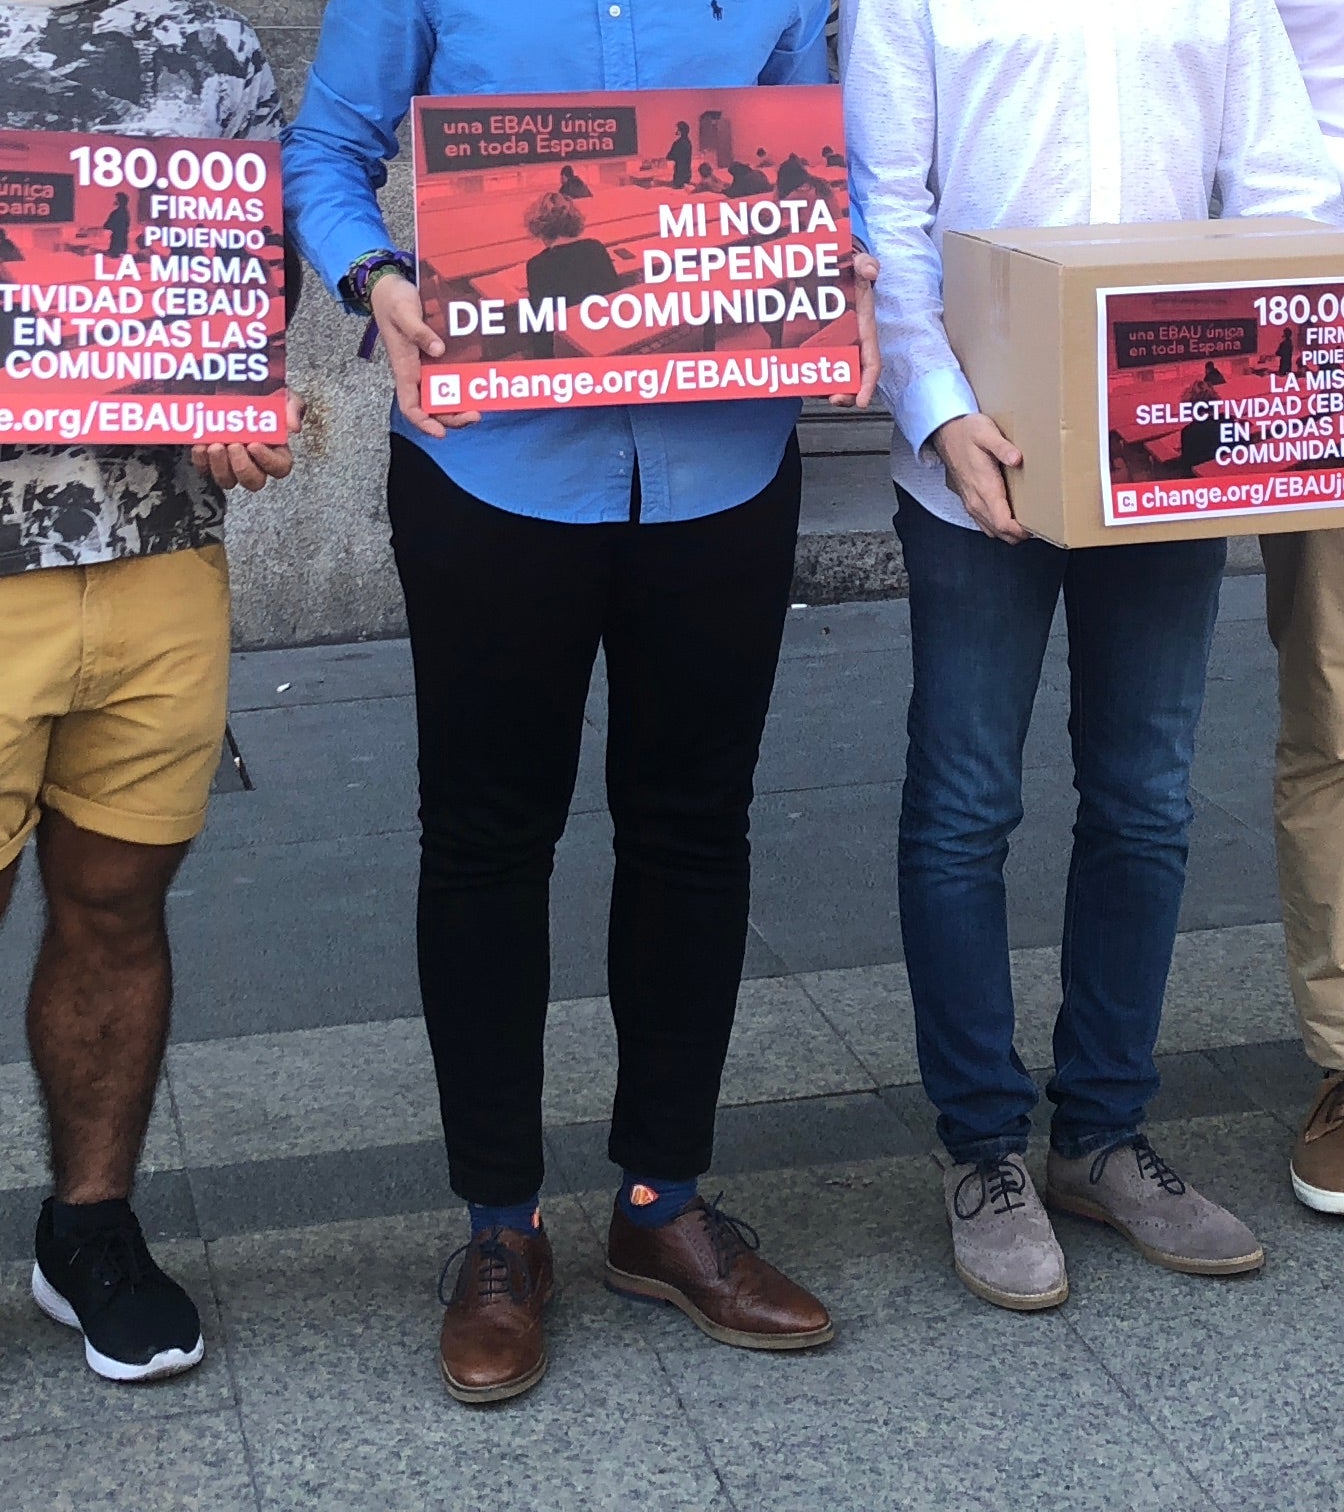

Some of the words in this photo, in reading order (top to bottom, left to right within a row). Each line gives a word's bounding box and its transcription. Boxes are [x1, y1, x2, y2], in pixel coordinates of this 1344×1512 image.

[443, 122, 483, 135] una
[490, 114, 554, 134] EBAU
[561, 113, 618, 134] única
[444, 143, 471, 157] en
[478, 136, 529, 155] toda
[536, 132, 614, 156] España
[69, 146, 268, 192] 180.000
[150, 195, 265, 223] FIRMAS
[658, 203, 707, 239] MI
[719, 198, 838, 237] NOTA
[144, 226, 266, 250] PIDIENDO
[94, 254, 141, 281] LA
[150, 255, 267, 284] MISMA
[642, 243, 841, 285] DEPENDE
[151, 287, 270, 318] (EBAU)
[448, 299, 506, 337] DE
[518, 295, 568, 334] MI
[578, 286, 847, 331] COMUNIDAD
[13, 317, 62, 346] EN
[70, 318, 192, 348] TODAS
[201, 320, 268, 349] LAS
[1159, 325, 1202, 340] EBAU
[4, 350, 270, 381] COMUNIDADES
[1129, 346, 1147, 357] en
[467, 354, 852, 403] change.org/EBAUjusta
[1270, 373, 1300, 393] LA
[1135, 396, 1302, 425] SELECTIVIDAD
[1219, 422, 1251, 444] EN
[1255, 417, 1334, 441] TODAS
